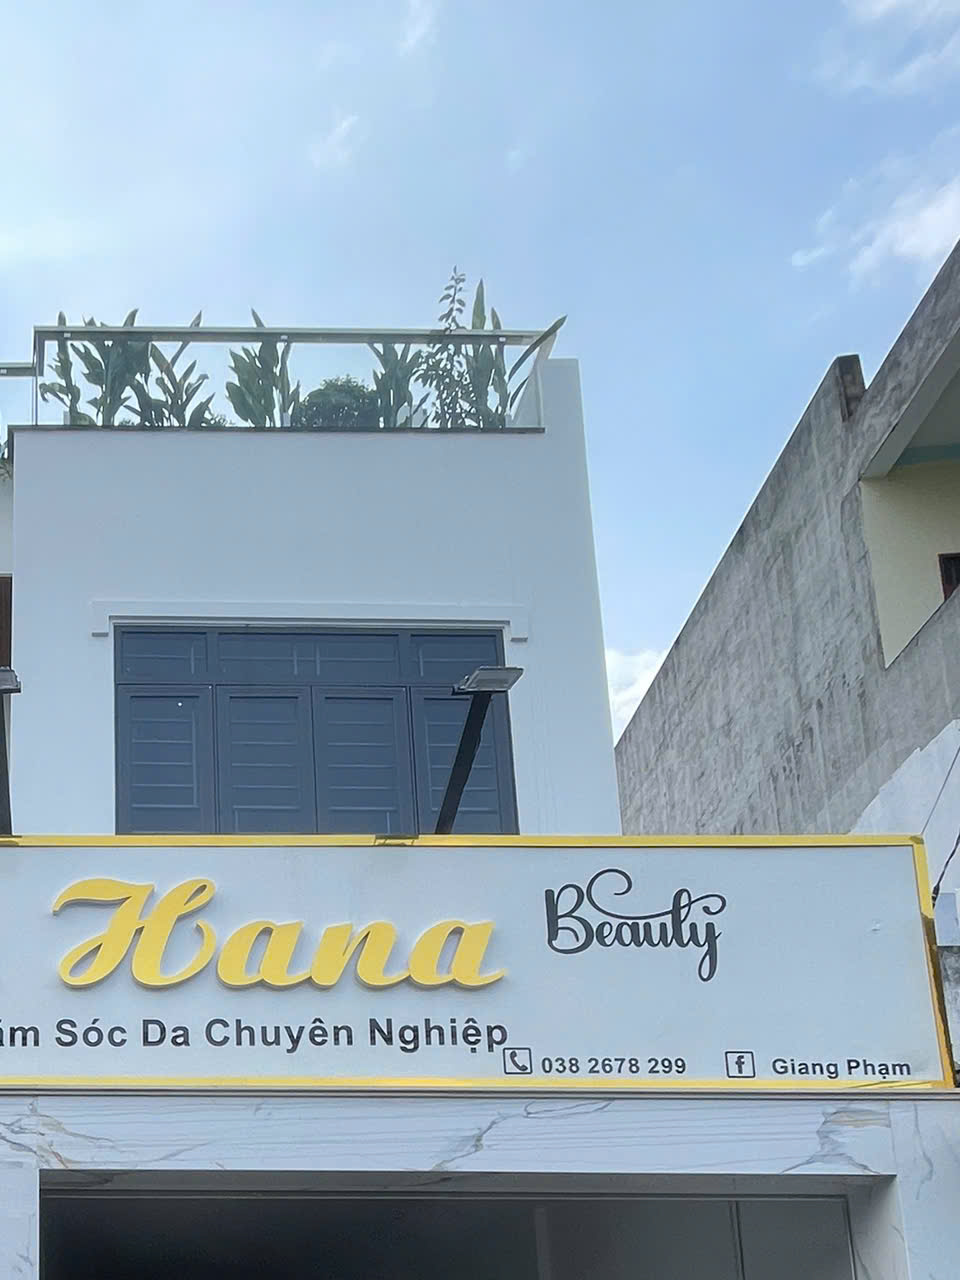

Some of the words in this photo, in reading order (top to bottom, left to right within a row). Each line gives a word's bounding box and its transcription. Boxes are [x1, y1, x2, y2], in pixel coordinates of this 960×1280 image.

[52, 877, 510, 989] Hana
[544, 867, 727, 982] Beauty
[54, 1018, 127, 1047] Sóc
[142, 1018, 191, 1047] Da
[204, 1017, 353, 1054] Chuyên
[368, 1017, 508, 1054] Nghiệp
[541, 1057, 580, 1074] 038
[587, 1057, 640, 1074] 2678
[647, 1057, 686, 1074] 299
[772, 1058, 839, 1079] Giang
[847, 1058, 911, 1079] Phạm
